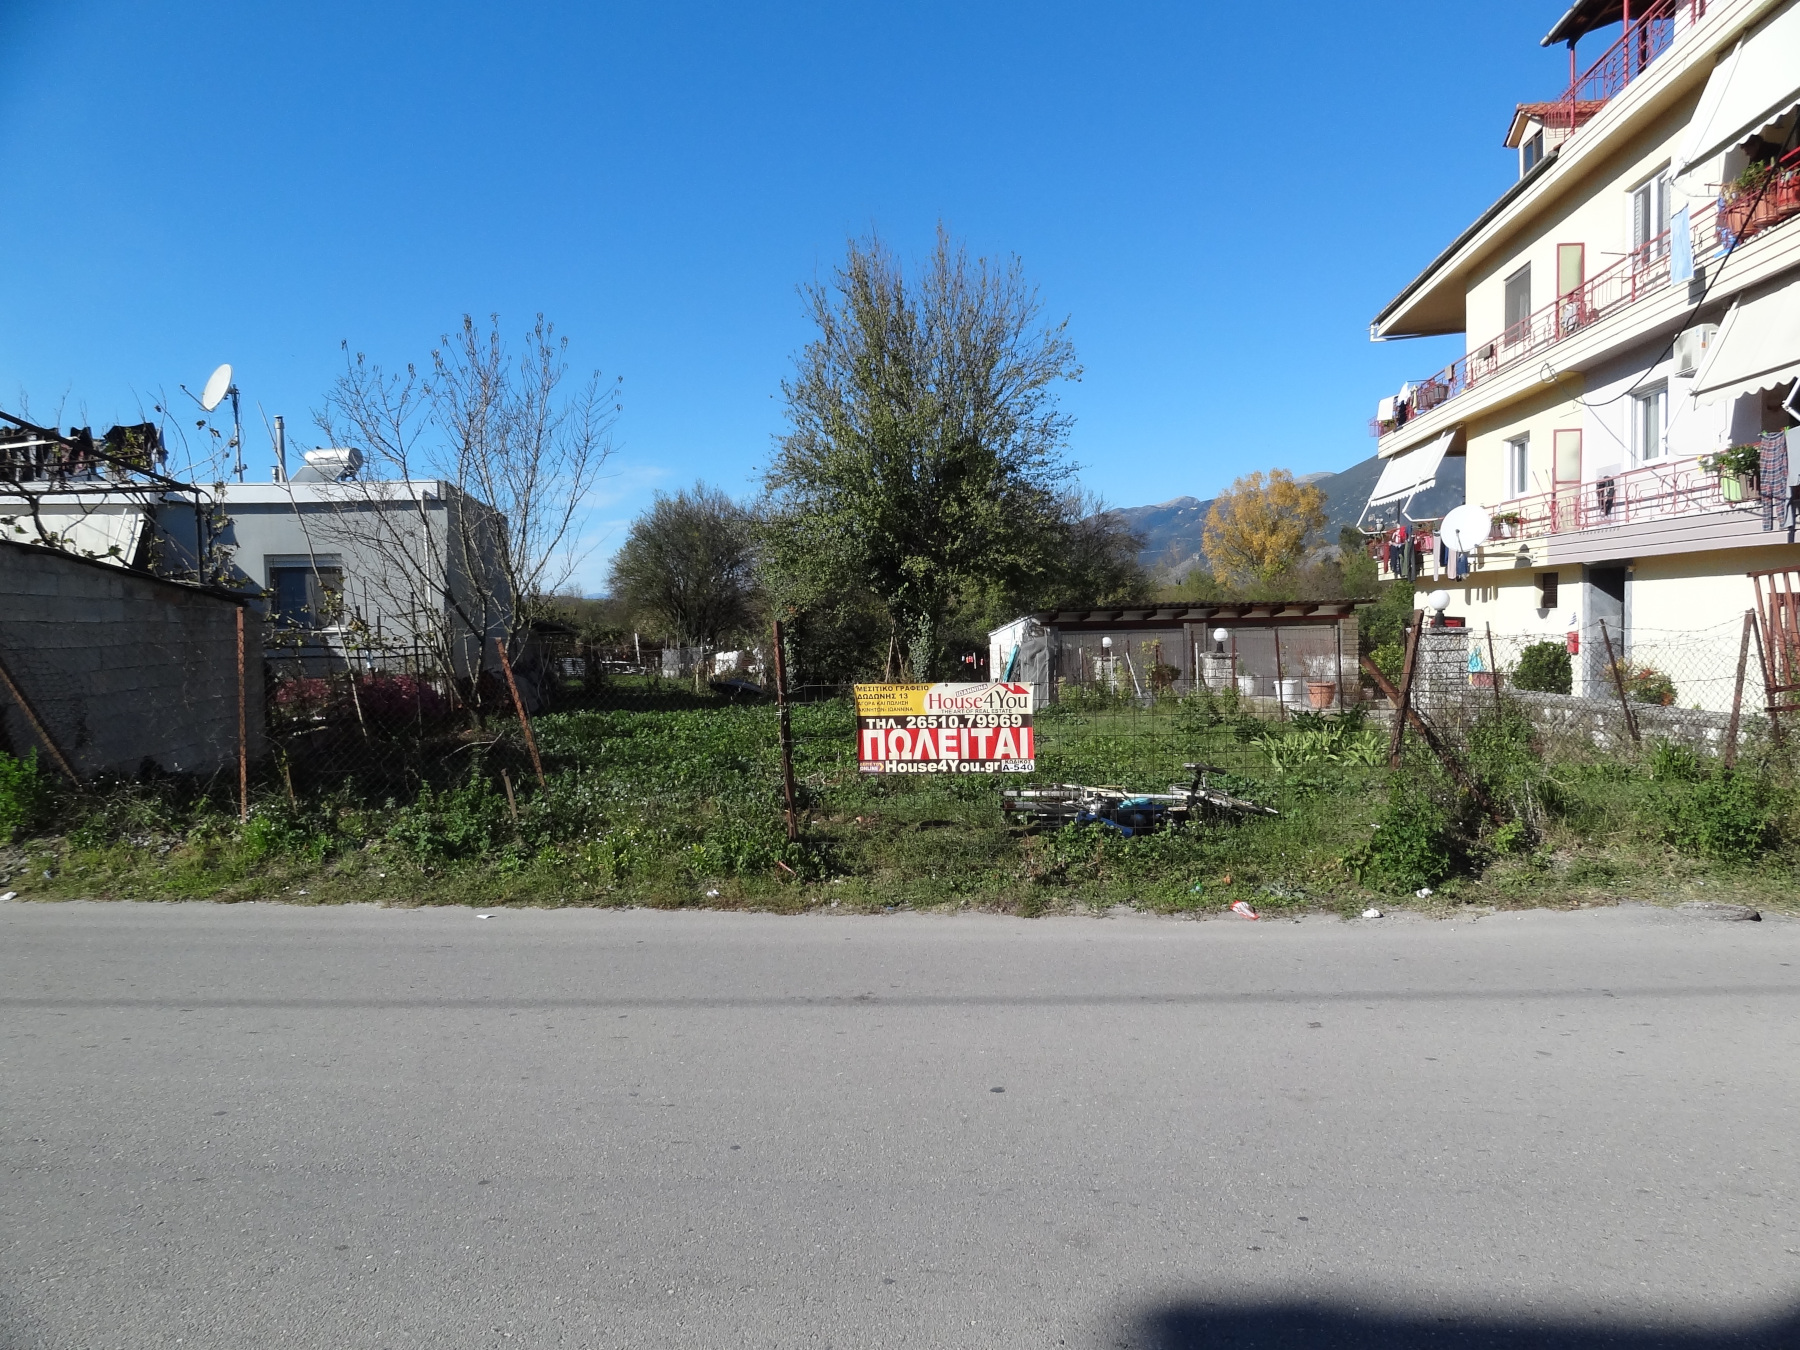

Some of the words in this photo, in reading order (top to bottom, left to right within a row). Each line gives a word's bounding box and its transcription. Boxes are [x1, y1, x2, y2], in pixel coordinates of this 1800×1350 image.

[928, 690, 1028, 709] House4You
[866, 718, 901, 729] ΤΗΛ.
[906, 714, 1023, 729] 26510.79969
[862, 727, 1029, 760] ΠΩΛΕΙΤΑΙ
[885, 760, 1000, 773] House4You.gr
